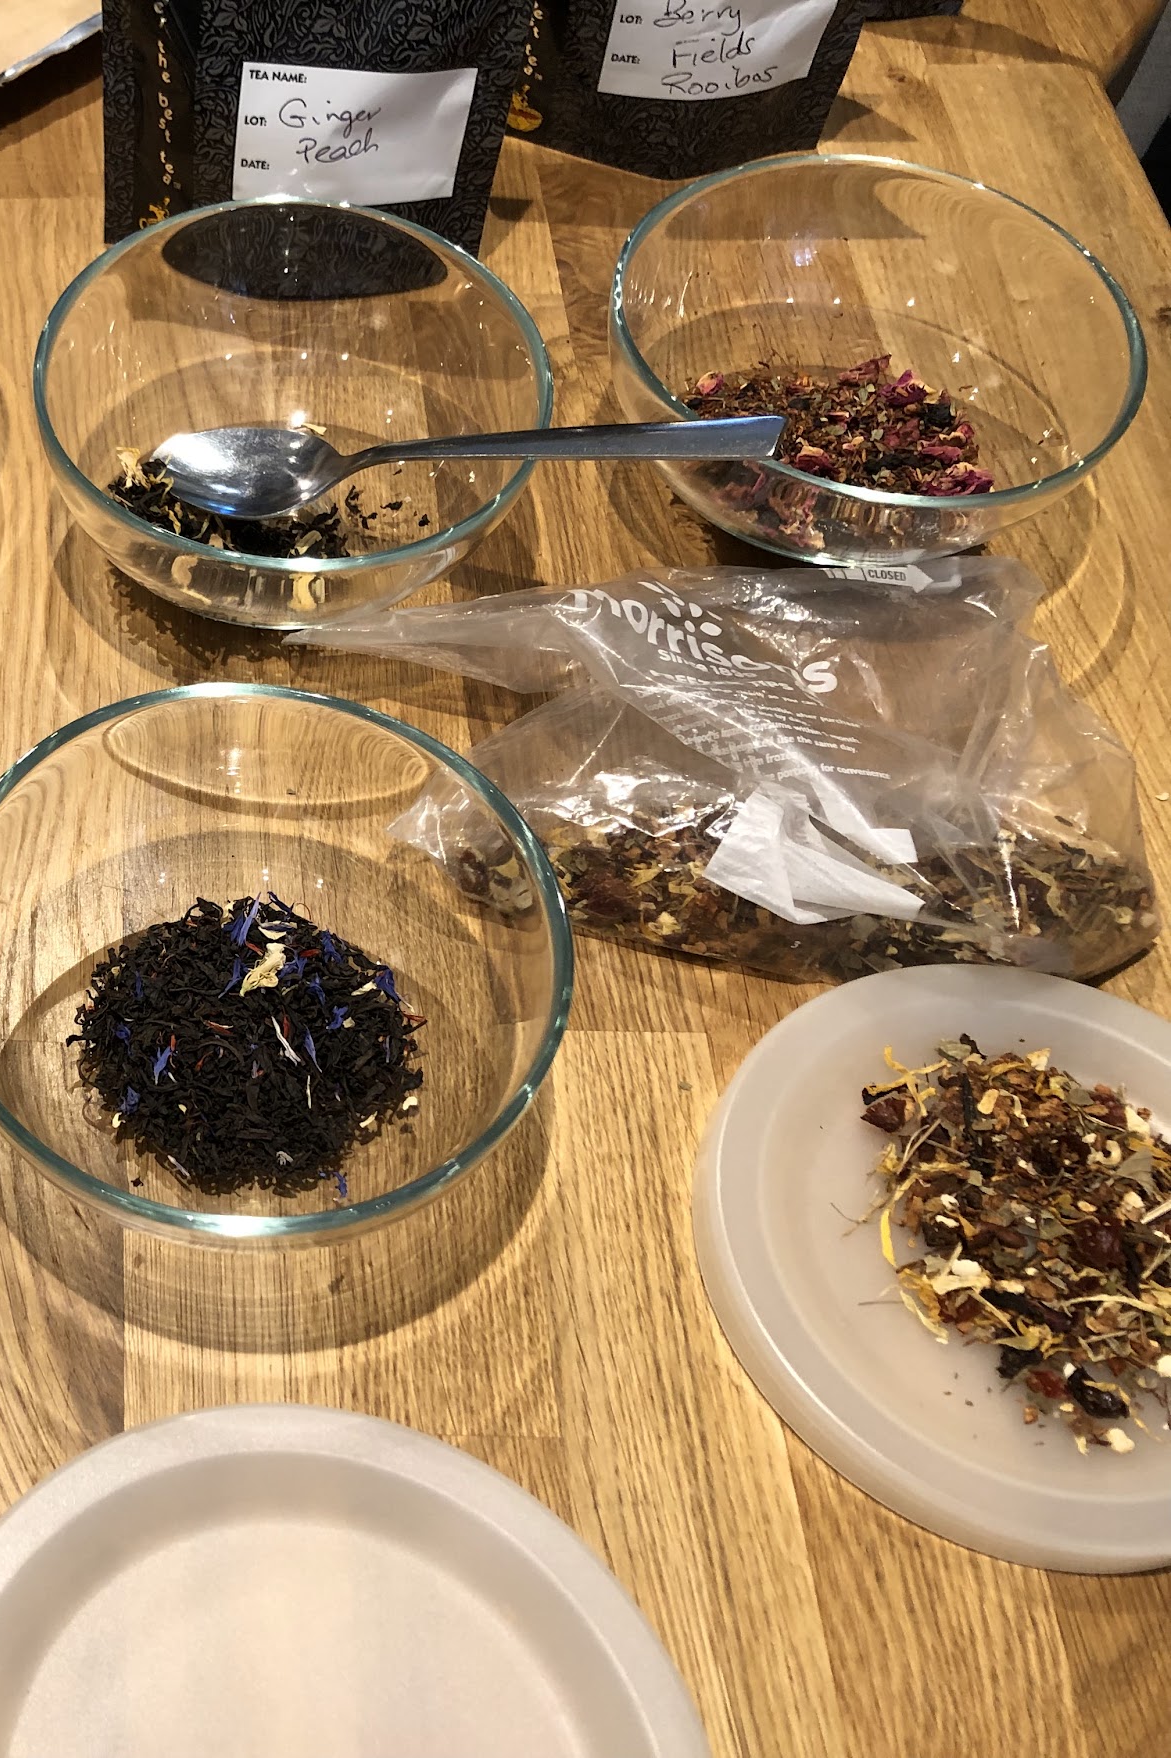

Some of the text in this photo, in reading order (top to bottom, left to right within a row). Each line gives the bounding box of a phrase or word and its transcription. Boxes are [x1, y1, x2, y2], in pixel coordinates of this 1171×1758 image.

[619, 14, 643, 25] LOT:
[652, 0, 741, 36] Berry
[672, 30, 756, 69] Fields
[158, 40, 172, 83] the
[611, 53, 640, 65] DATE:
[249, 69, 308, 84] TEA NAME:
[158, 92, 173, 143] best
[244, 115, 267, 127] LOT:
[278, 98, 381, 139] Ginger
[296, 127, 379, 164] Peach
[240, 158, 270, 170] DATE:
[867, 568, 907, 582] CLOSED
[797, 735, 813, 746] the
[814, 740, 838, 750] same
[820, 763, 835, 773] for
